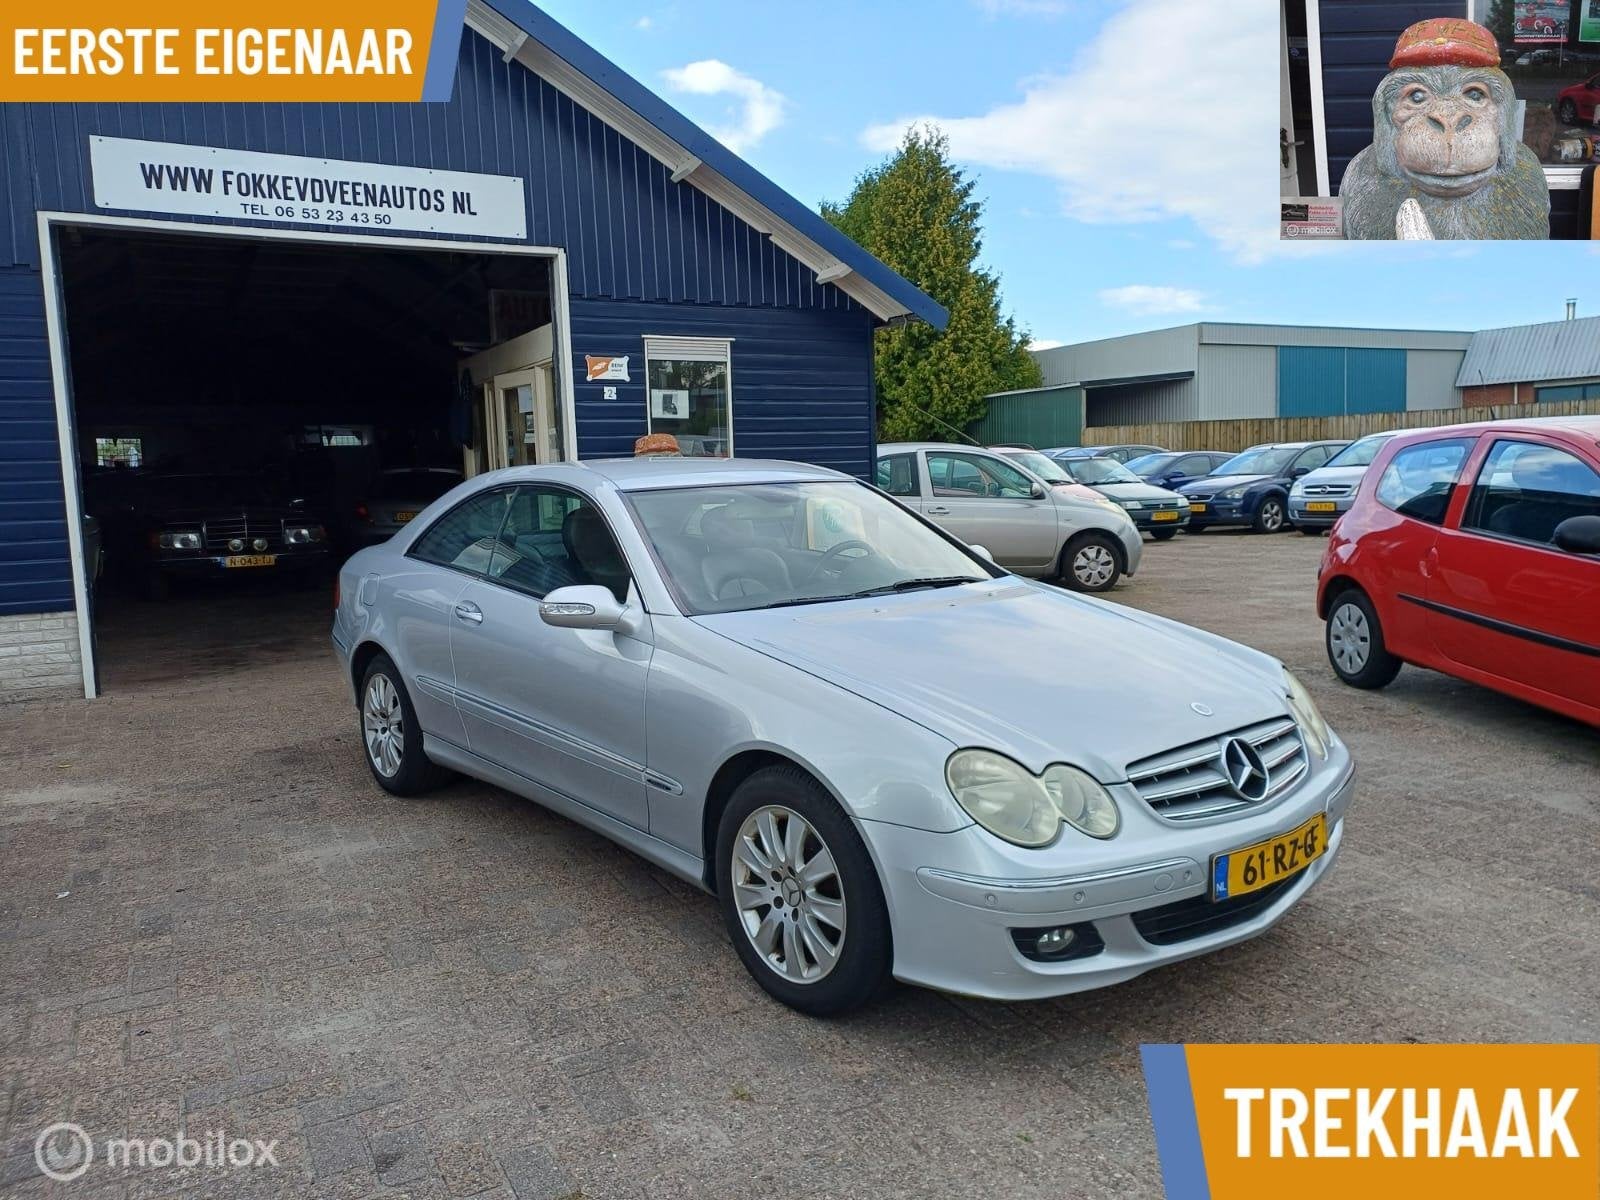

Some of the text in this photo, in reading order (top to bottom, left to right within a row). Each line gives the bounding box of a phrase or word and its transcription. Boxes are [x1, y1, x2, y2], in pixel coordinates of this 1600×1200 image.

[140, 162, 477, 216] WWW FOKKEVDVEENAUTOS NL
[240, 203, 392, 225] TEL 06 53 23 43 50
[607, 389, 614, 398] 2
[1243, 823, 1319, 886] 61-RZ-GF
